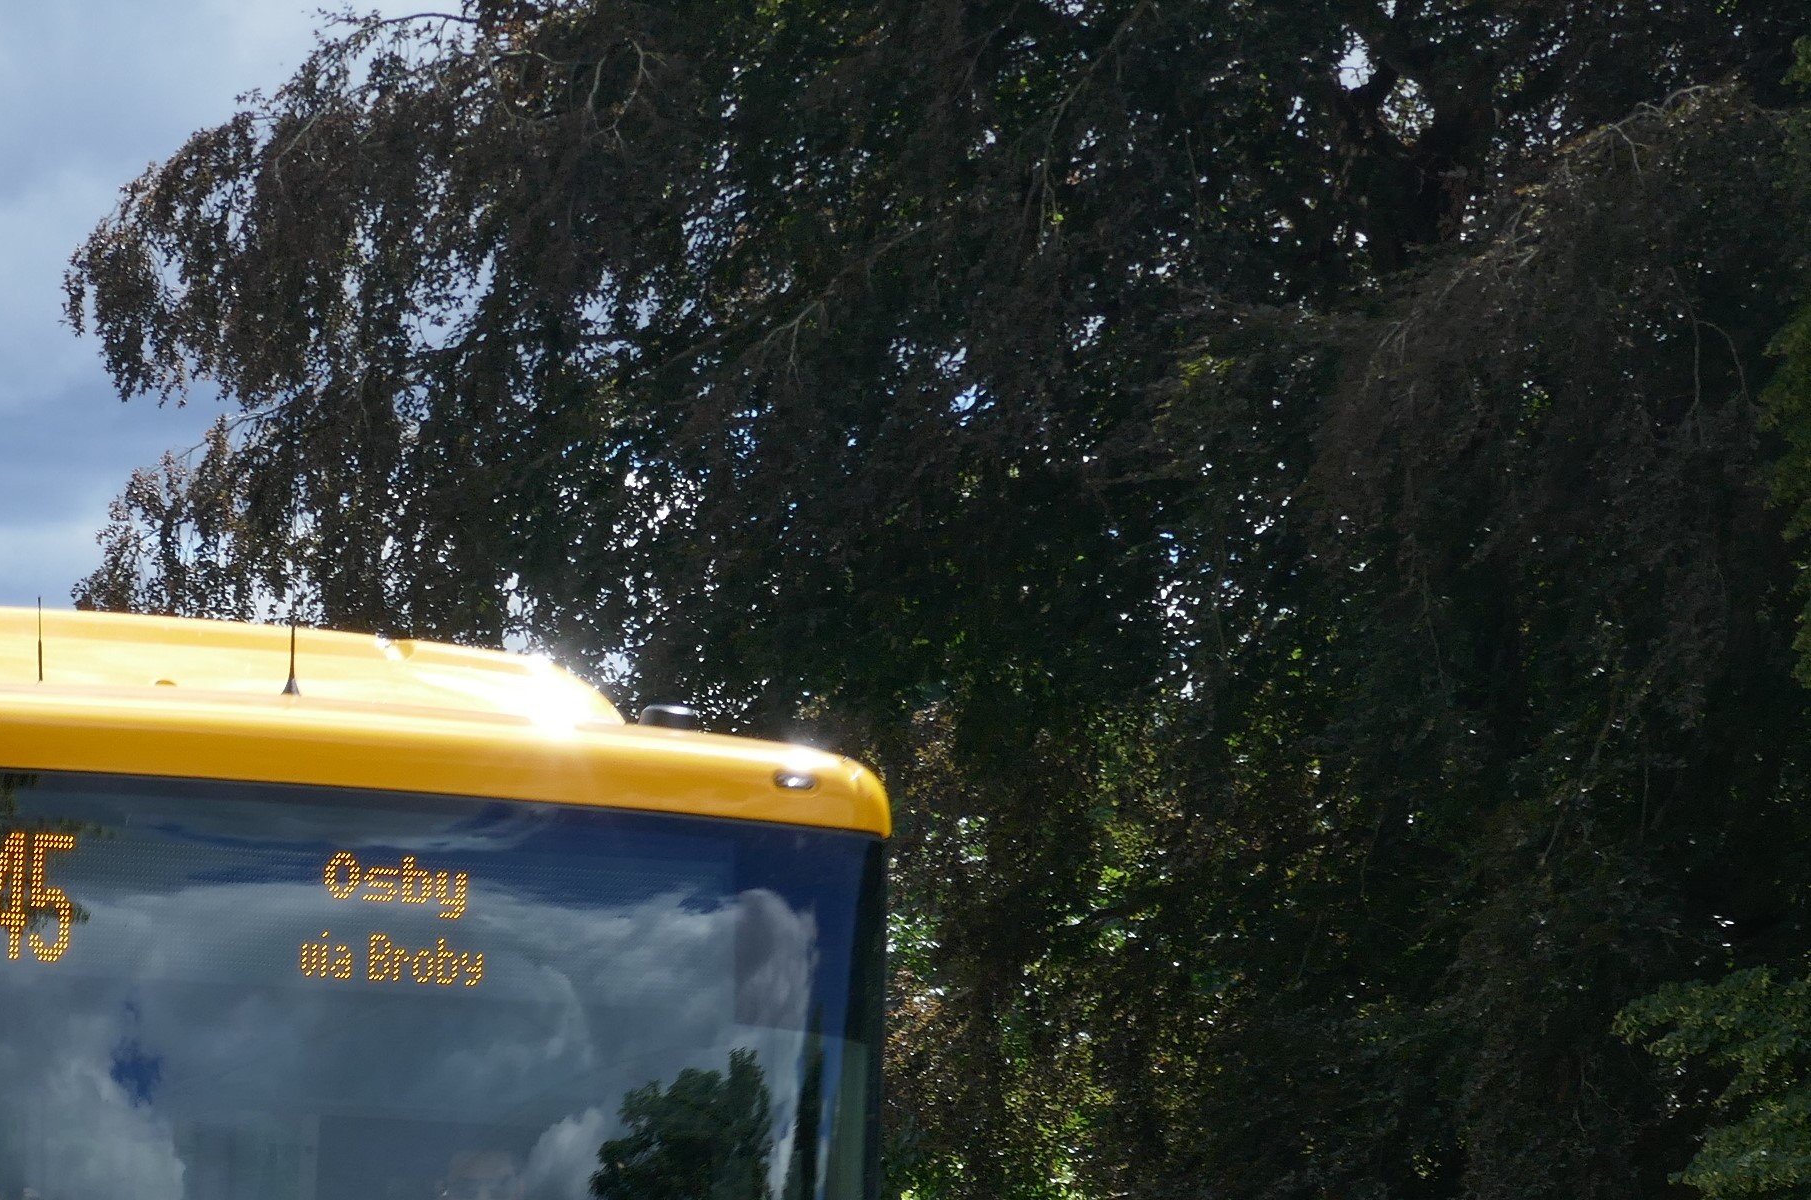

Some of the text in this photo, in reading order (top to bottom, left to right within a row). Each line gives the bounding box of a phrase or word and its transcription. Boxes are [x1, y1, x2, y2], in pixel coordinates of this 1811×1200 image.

[323, 851, 468, 919] Osby
[299, 931, 484, 986] via Broby
